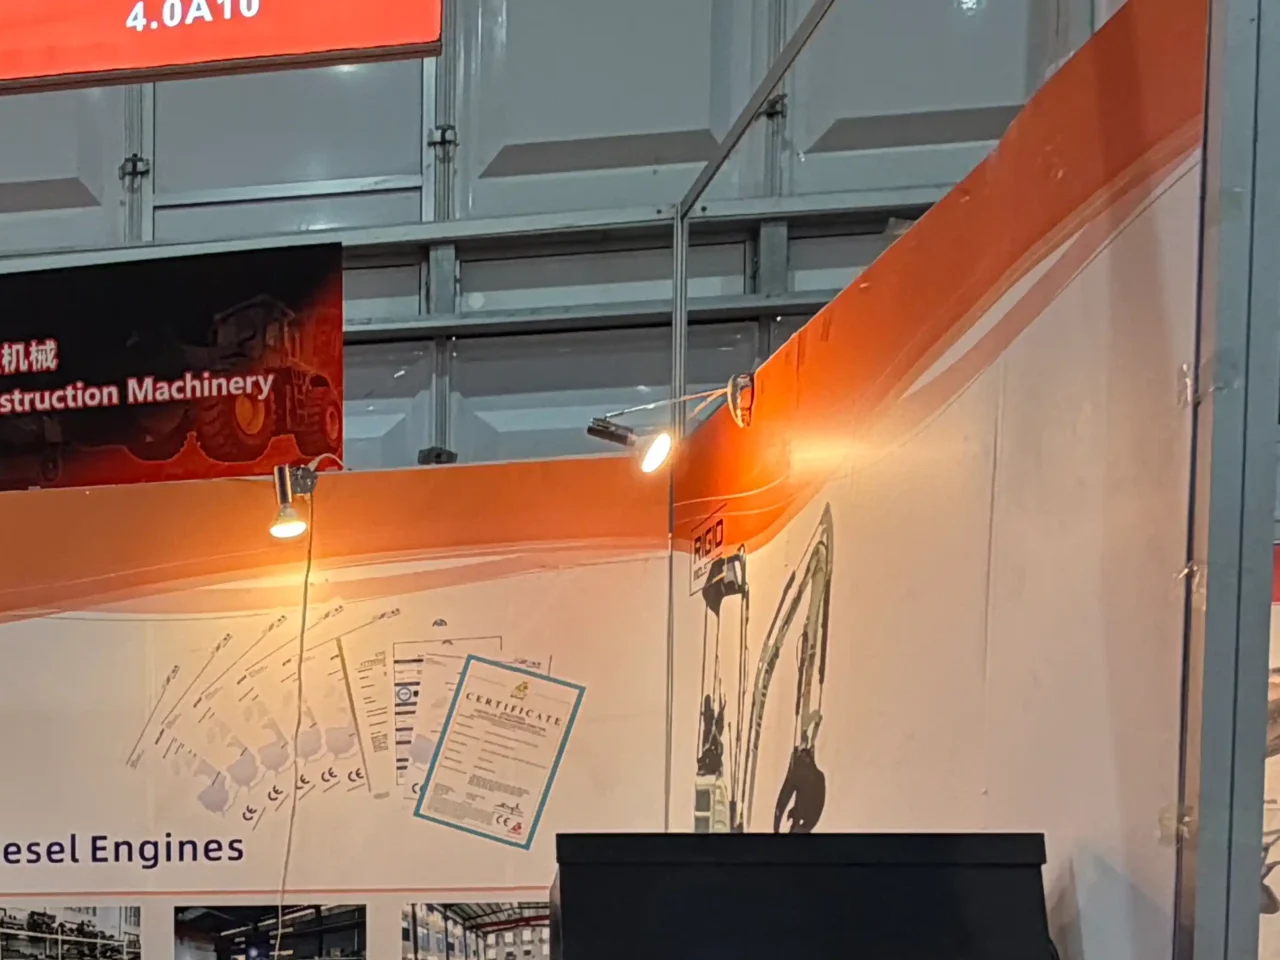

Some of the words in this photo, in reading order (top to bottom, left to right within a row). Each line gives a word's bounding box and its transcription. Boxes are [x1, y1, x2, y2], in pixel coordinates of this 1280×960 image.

[126, 0, 260, 32] 4.0A10
[126, 371, 276, 405] Machinery
[466, 691, 562, 726] CERTIFICATE
[90, 832, 244, 870] Engines
